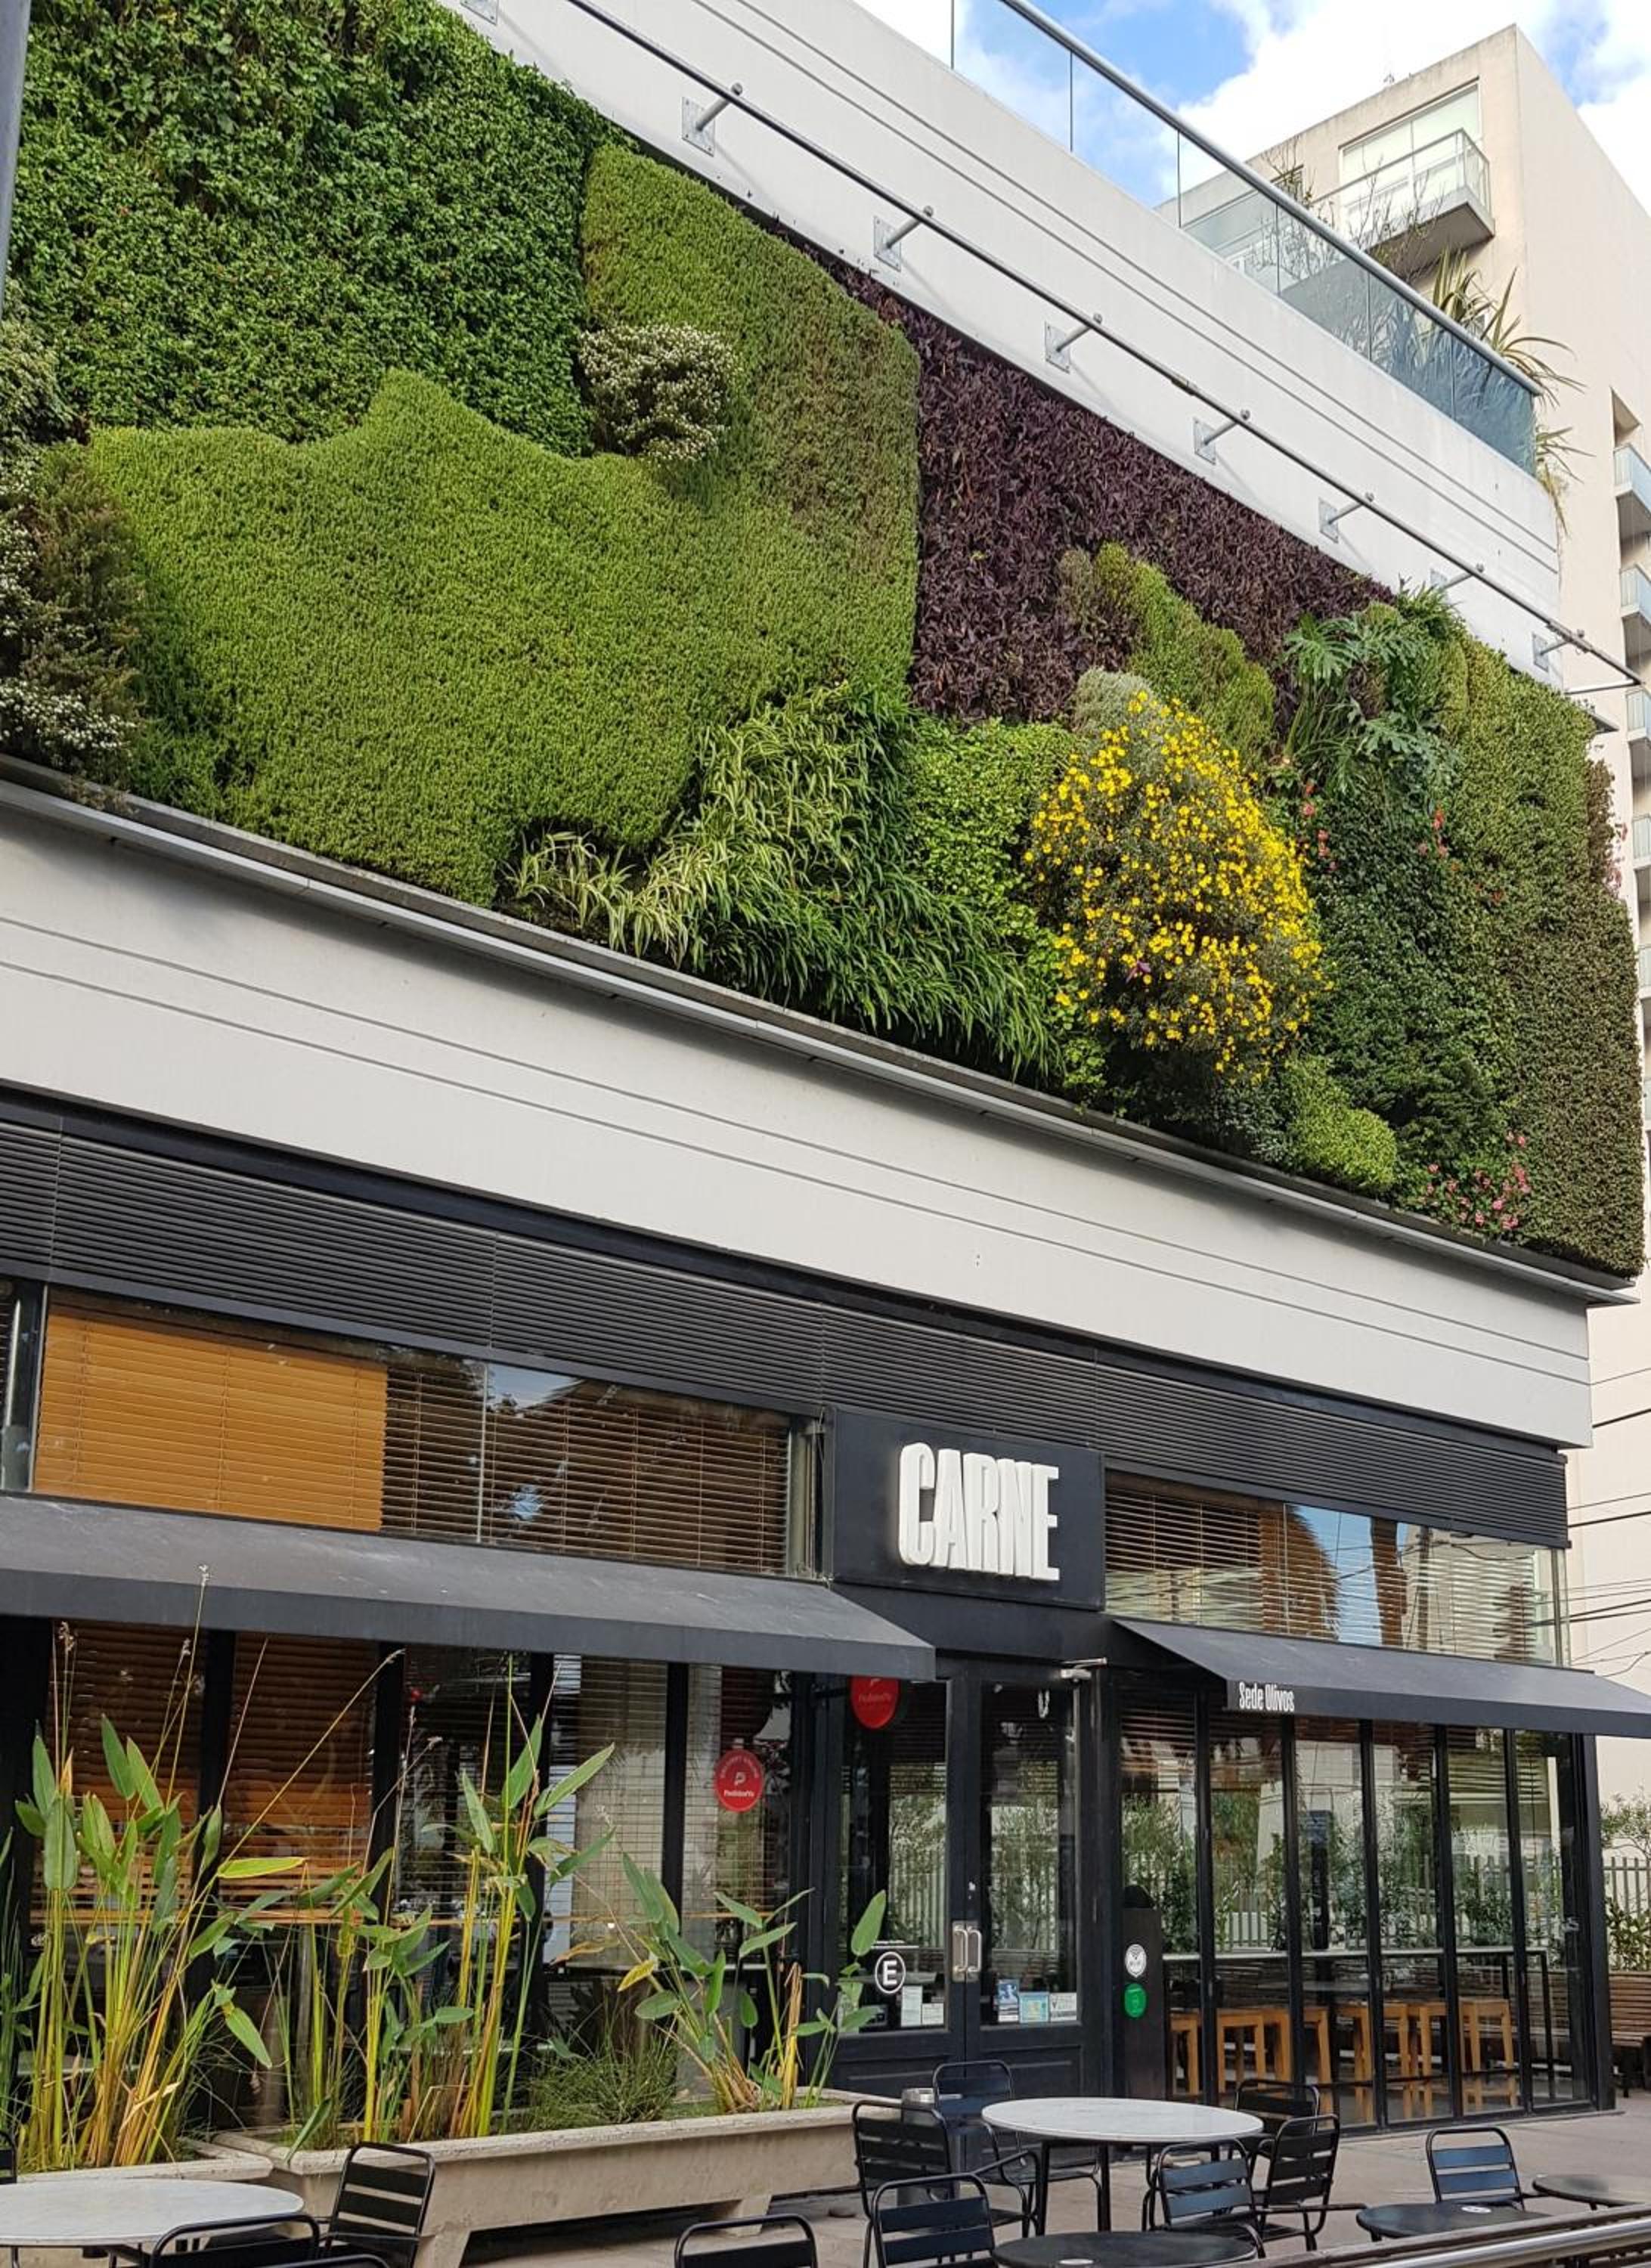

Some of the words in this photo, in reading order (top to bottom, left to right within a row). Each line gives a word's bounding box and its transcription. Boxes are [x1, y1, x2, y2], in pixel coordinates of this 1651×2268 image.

[898, 1442, 1060, 1581] CARNE
[1239, 1681, 1263, 1710] Sede
[1265, 1684, 1295, 1712] Olivos
[882, 1960, 897, 1986] E
